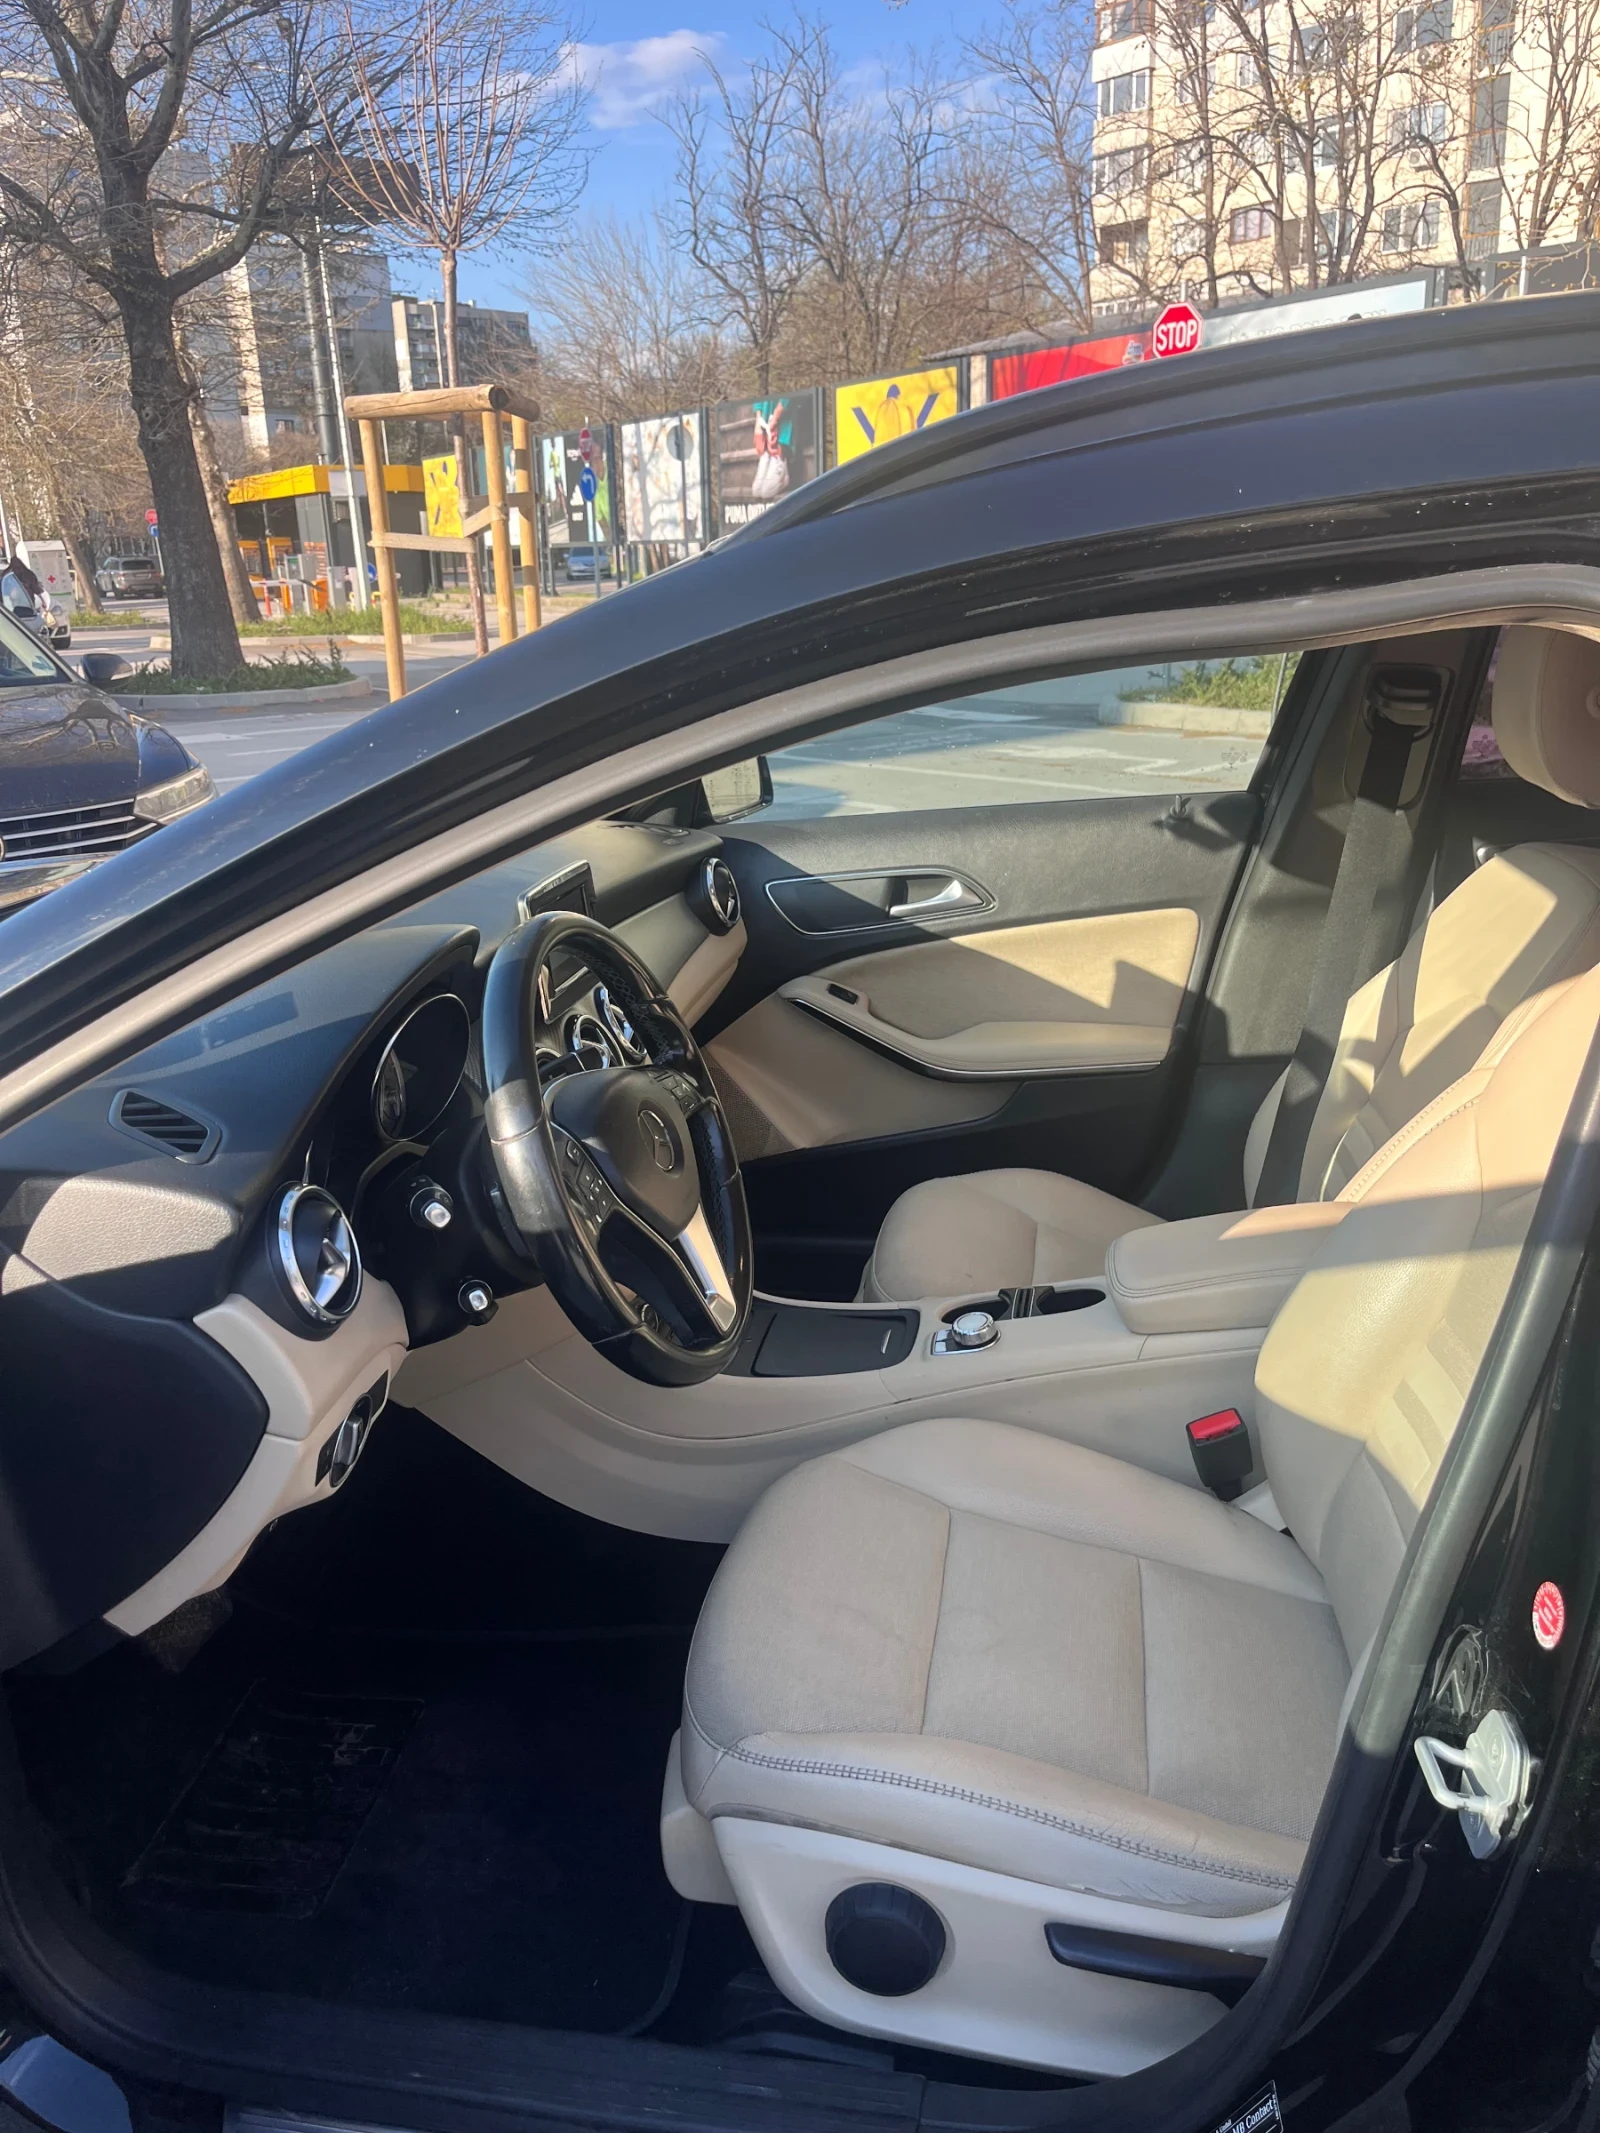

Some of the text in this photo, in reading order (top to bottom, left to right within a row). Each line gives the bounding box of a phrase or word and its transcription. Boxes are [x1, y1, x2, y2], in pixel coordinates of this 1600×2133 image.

[1156, 319, 1198, 352] STOP
[725, 503, 775, 524] PUMA OUT
[1246, 2099, 1273, 2128] Contact
